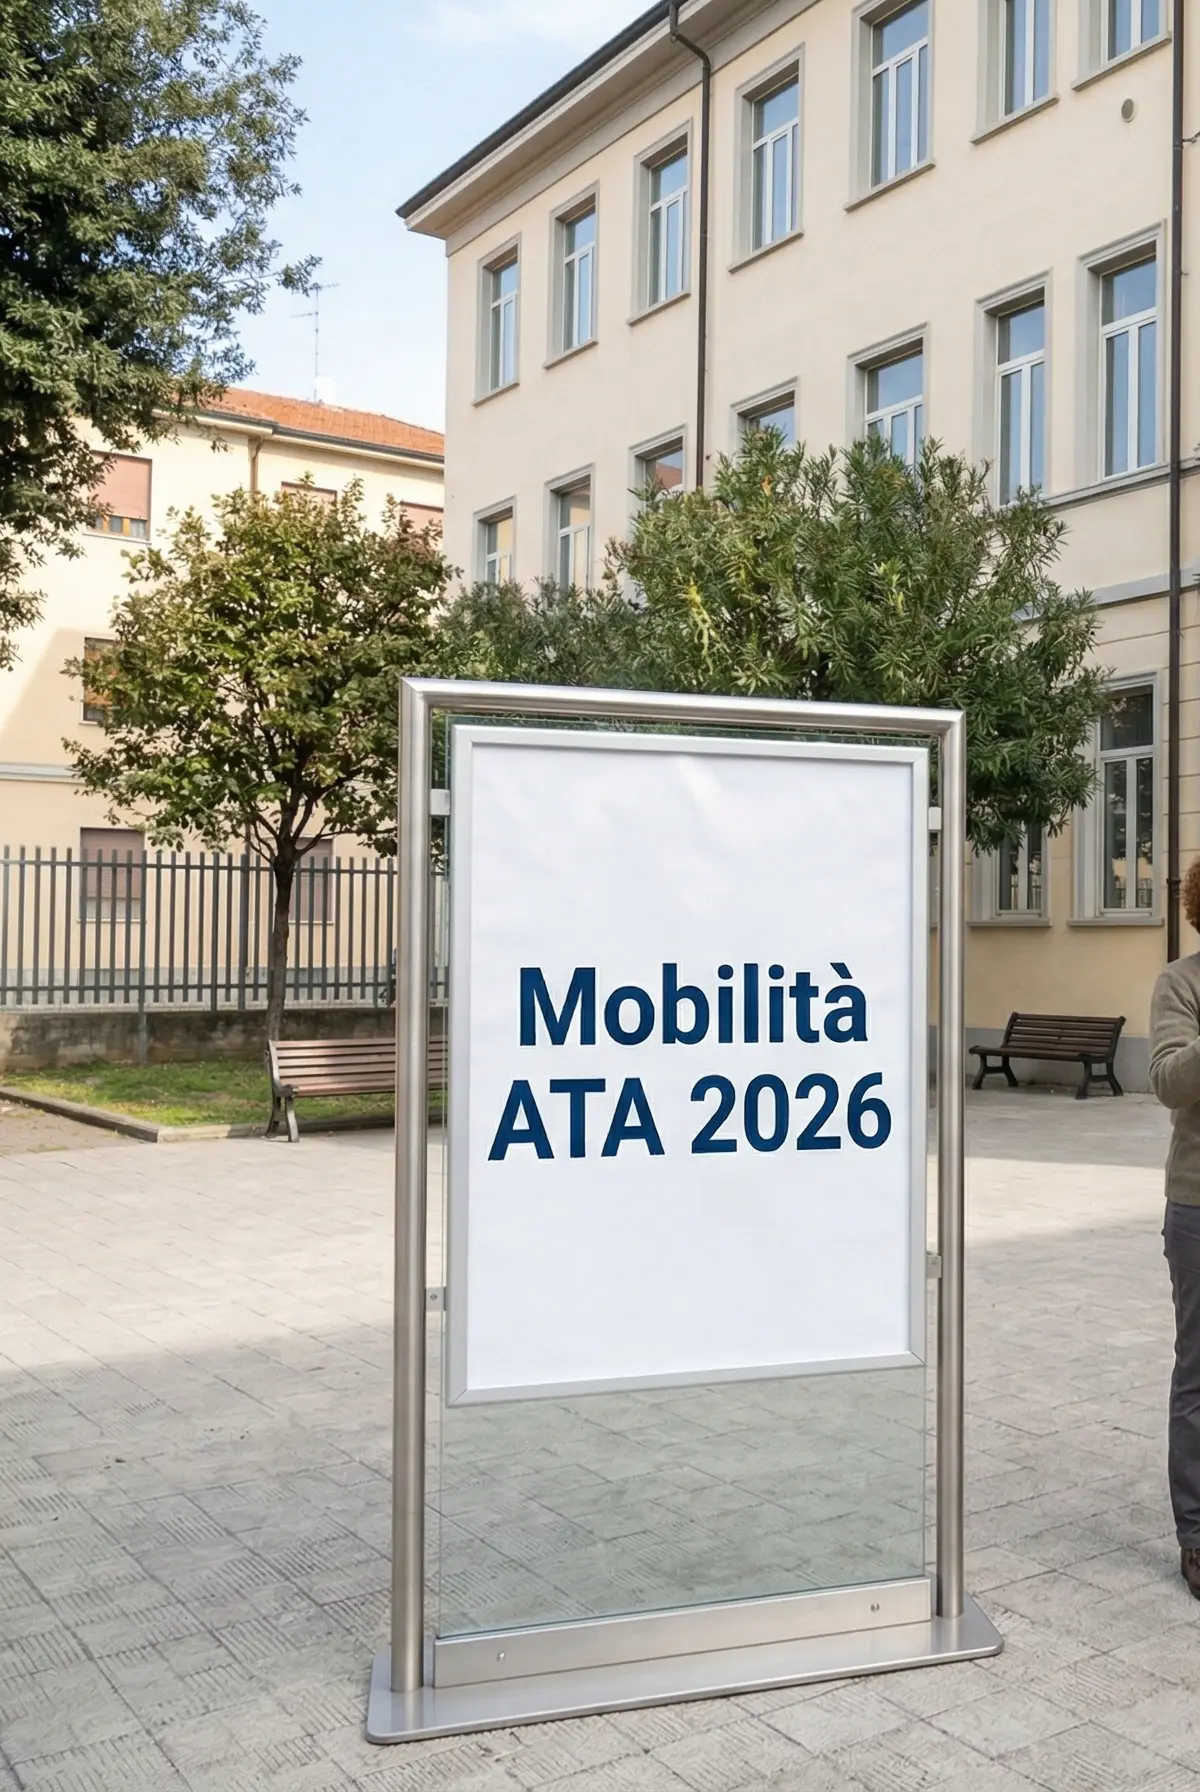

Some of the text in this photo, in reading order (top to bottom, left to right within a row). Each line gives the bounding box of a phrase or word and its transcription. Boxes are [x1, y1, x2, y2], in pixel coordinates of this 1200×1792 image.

[519, 962, 869, 1047] Mobilità
[487, 1071, 892, 1162] ATA 2026
